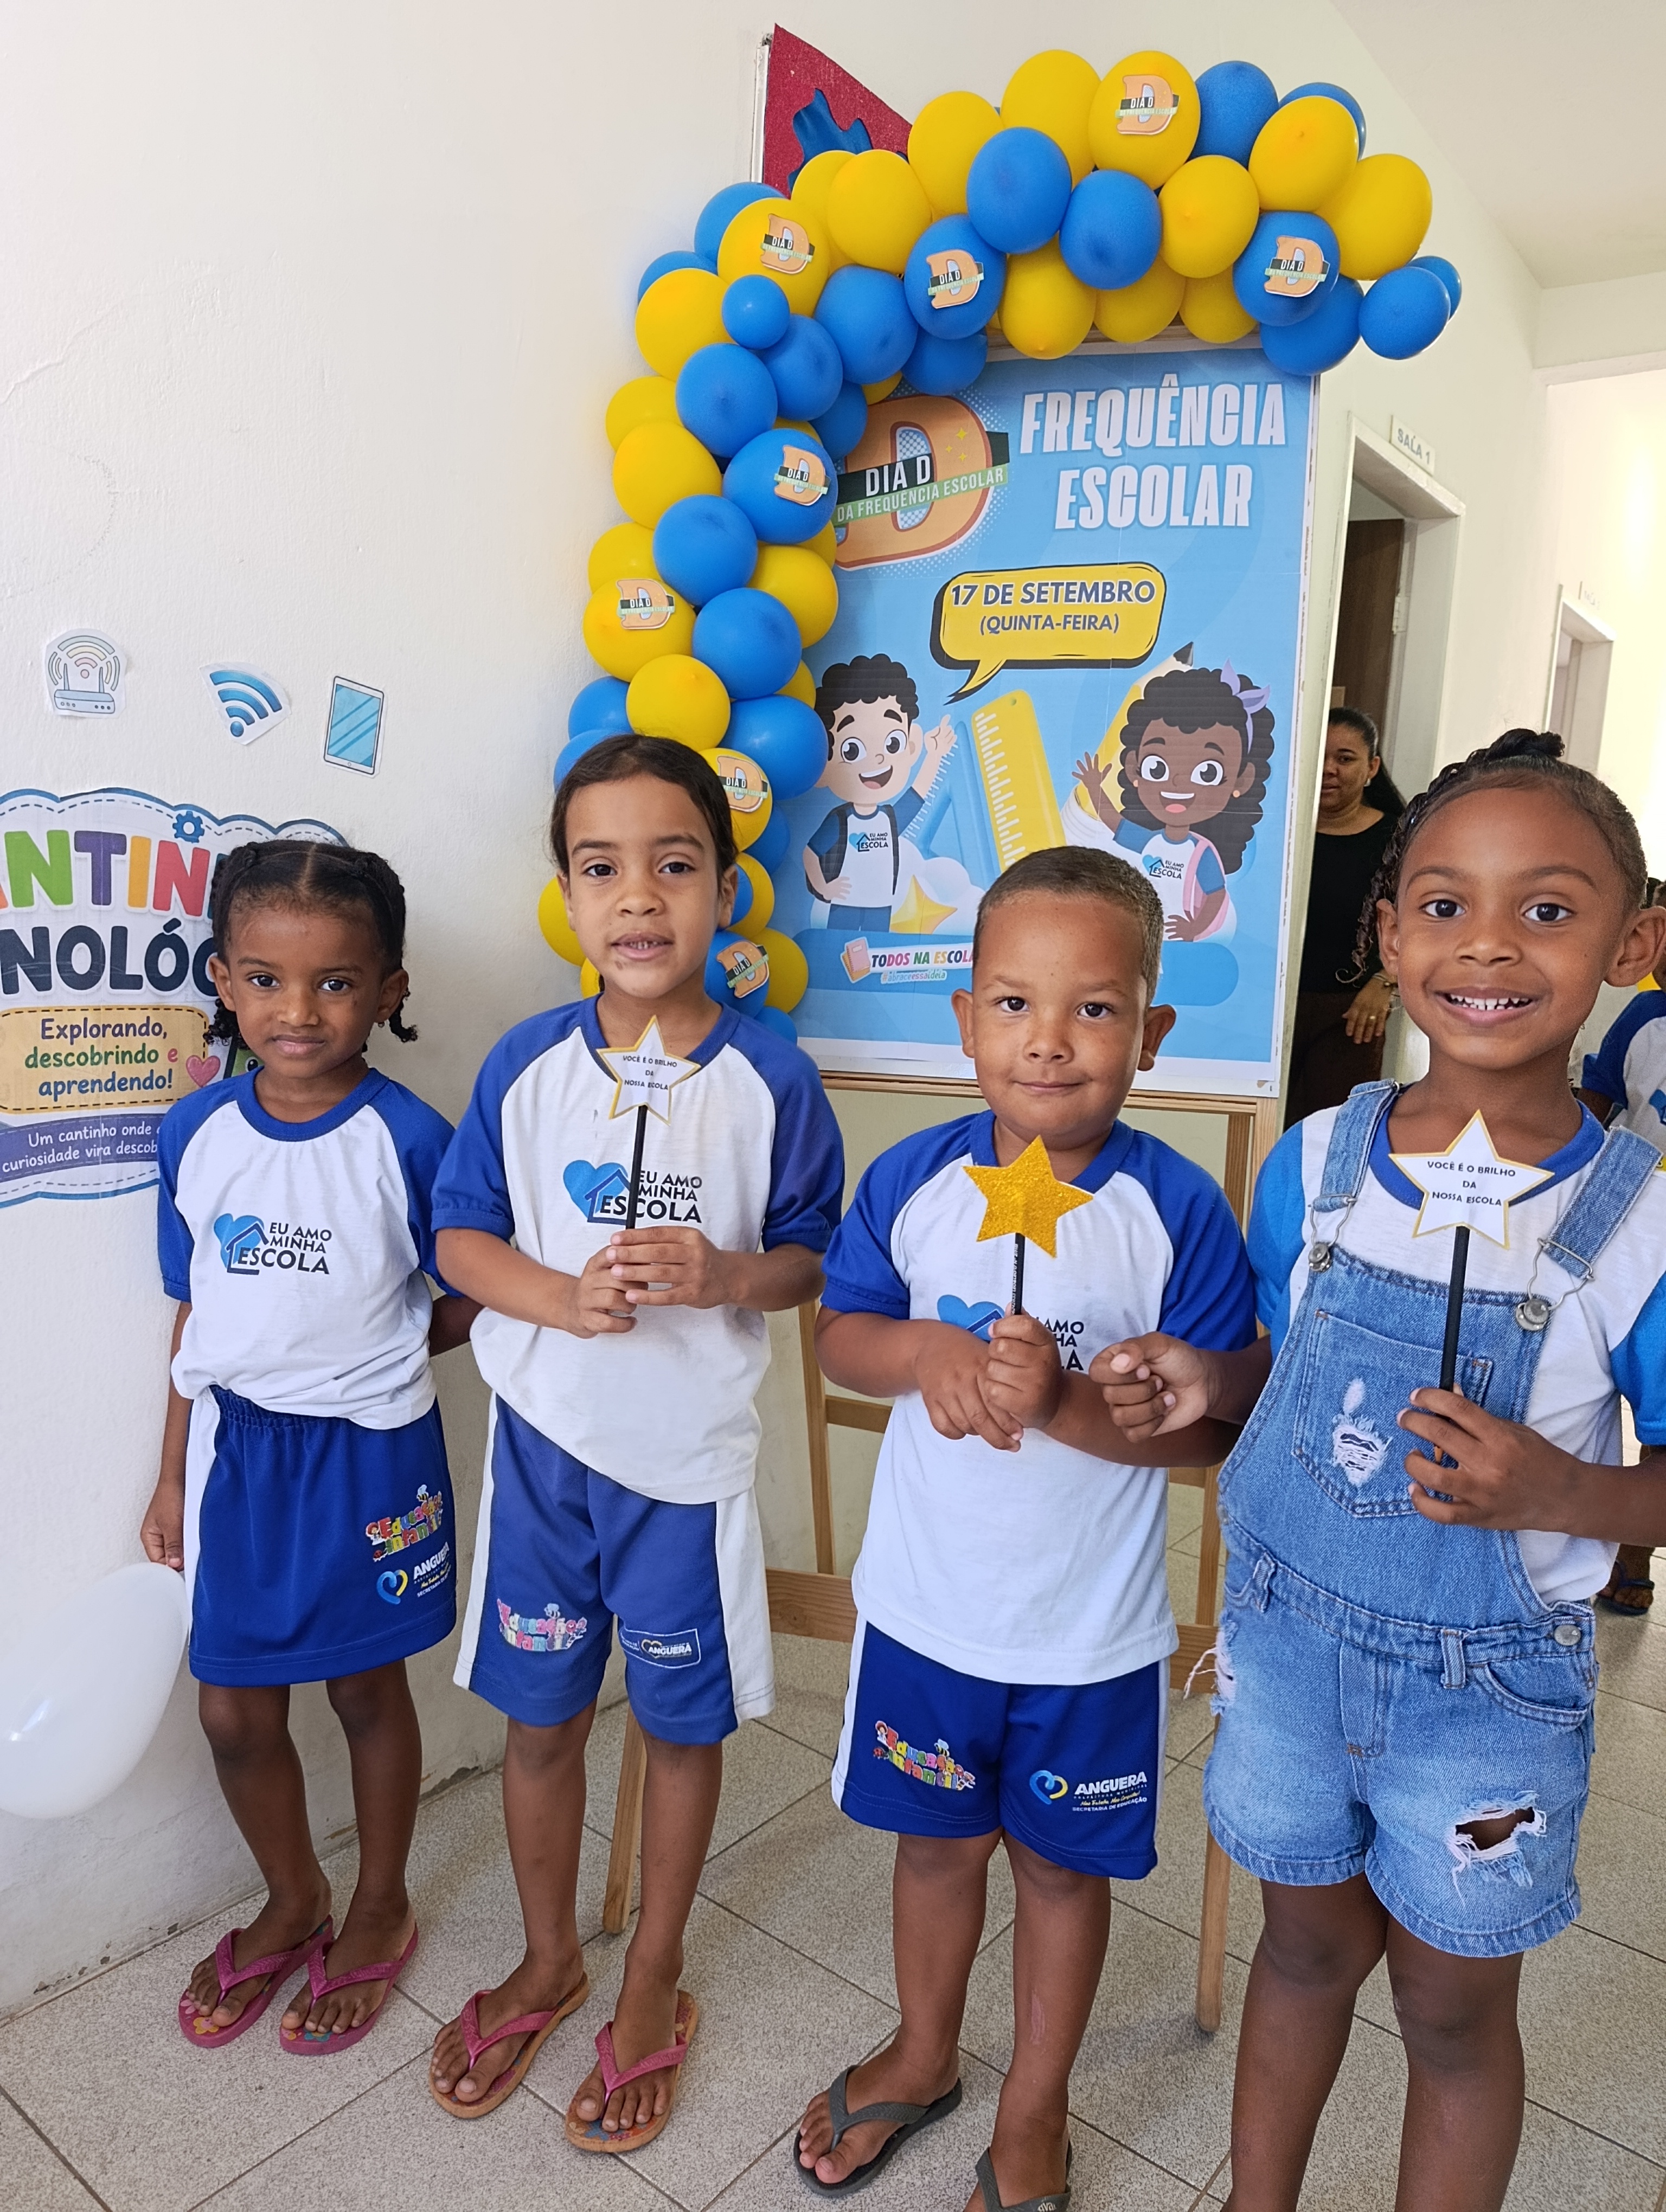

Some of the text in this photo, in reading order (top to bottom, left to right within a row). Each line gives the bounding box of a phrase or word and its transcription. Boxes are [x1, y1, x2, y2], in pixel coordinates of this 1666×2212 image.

[1131, 97, 1154, 108] DIA D
[772, 236, 792, 249] DIA D
[1280, 260, 1304, 271] DIA D
[939, 271, 960, 285] DIA D
[1020, 374, 1286, 457] FREQUÊNCIA
[1398, 428, 1430, 465] SALA 1
[787, 468, 808, 481] DIA D
[866, 455, 931, 497] DIA D
[837, 467, 1003, 523] DA FREQUÊNCIA ESCOLAR
[1055, 465, 1252, 529] ESCOLAR
[951, 581, 1155, 606] 17 DE SETEMBRO
[630, 598, 651, 608] DIA D
[980, 614, 1119, 635] (QUINTA-FEIRA)
[727, 777, 746, 788] DIA D
[0, 830, 222, 917] NTIN
[1153, 867, 1182, 879] ESCOLA
[733, 959, 750, 975] DIA D
[872, 953, 910, 967] TODOS
[913, 952, 930, 964] NA
[882, 970, 946, 982] #abraceessaideia
[41, 1016, 168, 1045] Explorando,
[25, 1043, 178, 1069] descobrindo e
[623, 1055, 640, 1063] VOCÊ
[655, 1059, 677, 1067] BRILHO
[39, 1069, 172, 1102] aprendendo!
[28, 1134, 53, 1148] Um
[59, 1123, 117, 1142] cantinho
[121, 1122, 151, 1136] onde
[2, 1145, 80, 1173] curiosidade
[85, 1140, 111, 1158] vira
[1427, 1161, 1454, 1171] VOCÊ
[1458, 1163, 1464, 1171] É
[1477, 1167, 1516, 1177] BRILHO
[661, 1173, 702, 1189] AMO
[1463, 1180, 1476, 1189] DA
[639, 1184, 698, 1202] MINHA
[1432, 1192, 1502, 1206] NOSSA ESCOLA
[600, 1194, 702, 1224] ESCOLA
[270, 1222, 332, 1242] EU AMO
[270, 1234, 326, 1253] MINHA
[238, 1246, 330, 1275] ESCOLA
[648, 1644, 692, 1655] ANGUERA
[1074, 1771, 1147, 1795] ANGUERA
[1117, 1796, 1147, 1808] EDUCAÇÃO
